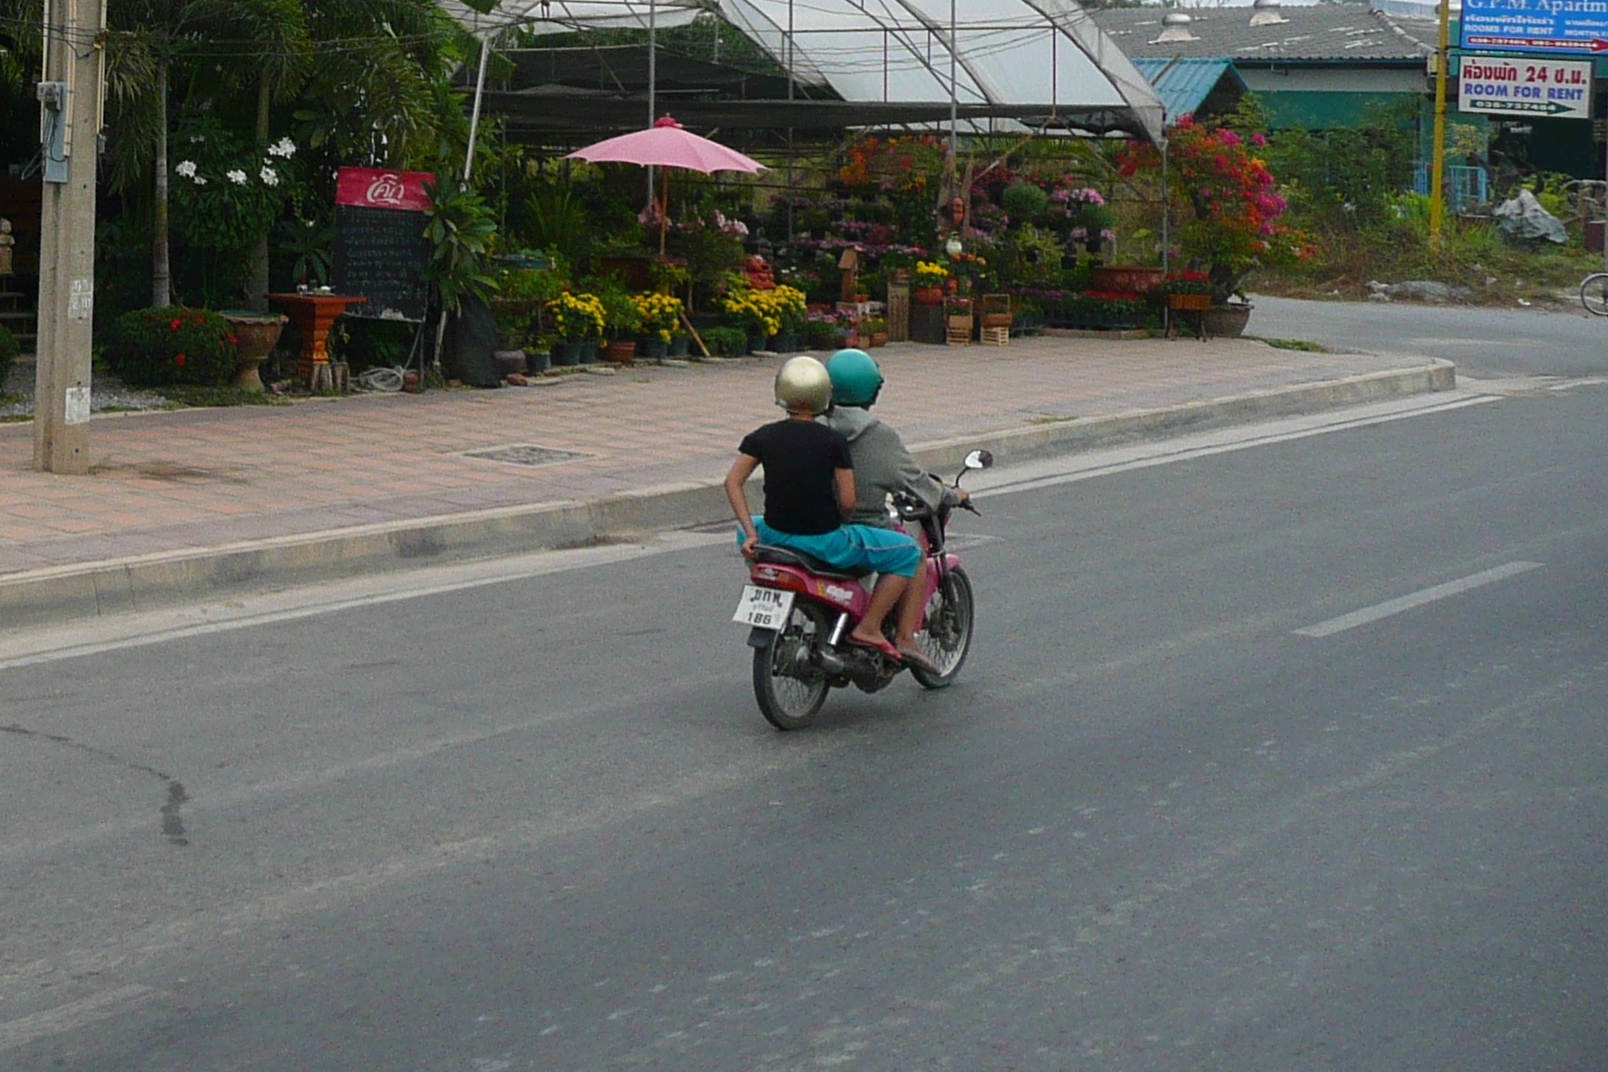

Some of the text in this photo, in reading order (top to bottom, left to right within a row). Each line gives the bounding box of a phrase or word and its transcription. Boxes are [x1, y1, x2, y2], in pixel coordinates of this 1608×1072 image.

[1464, 24, 1500, 33] ROOMS
[1503, 25, 1524, 34] FOR
[1527, 26, 1555, 35] RENT
[1463, 59, 1518, 82] ห้องพัก
[1525, 65, 1548, 83] 24
[1464, 83, 1585, 101] ROOM FOR RENT
